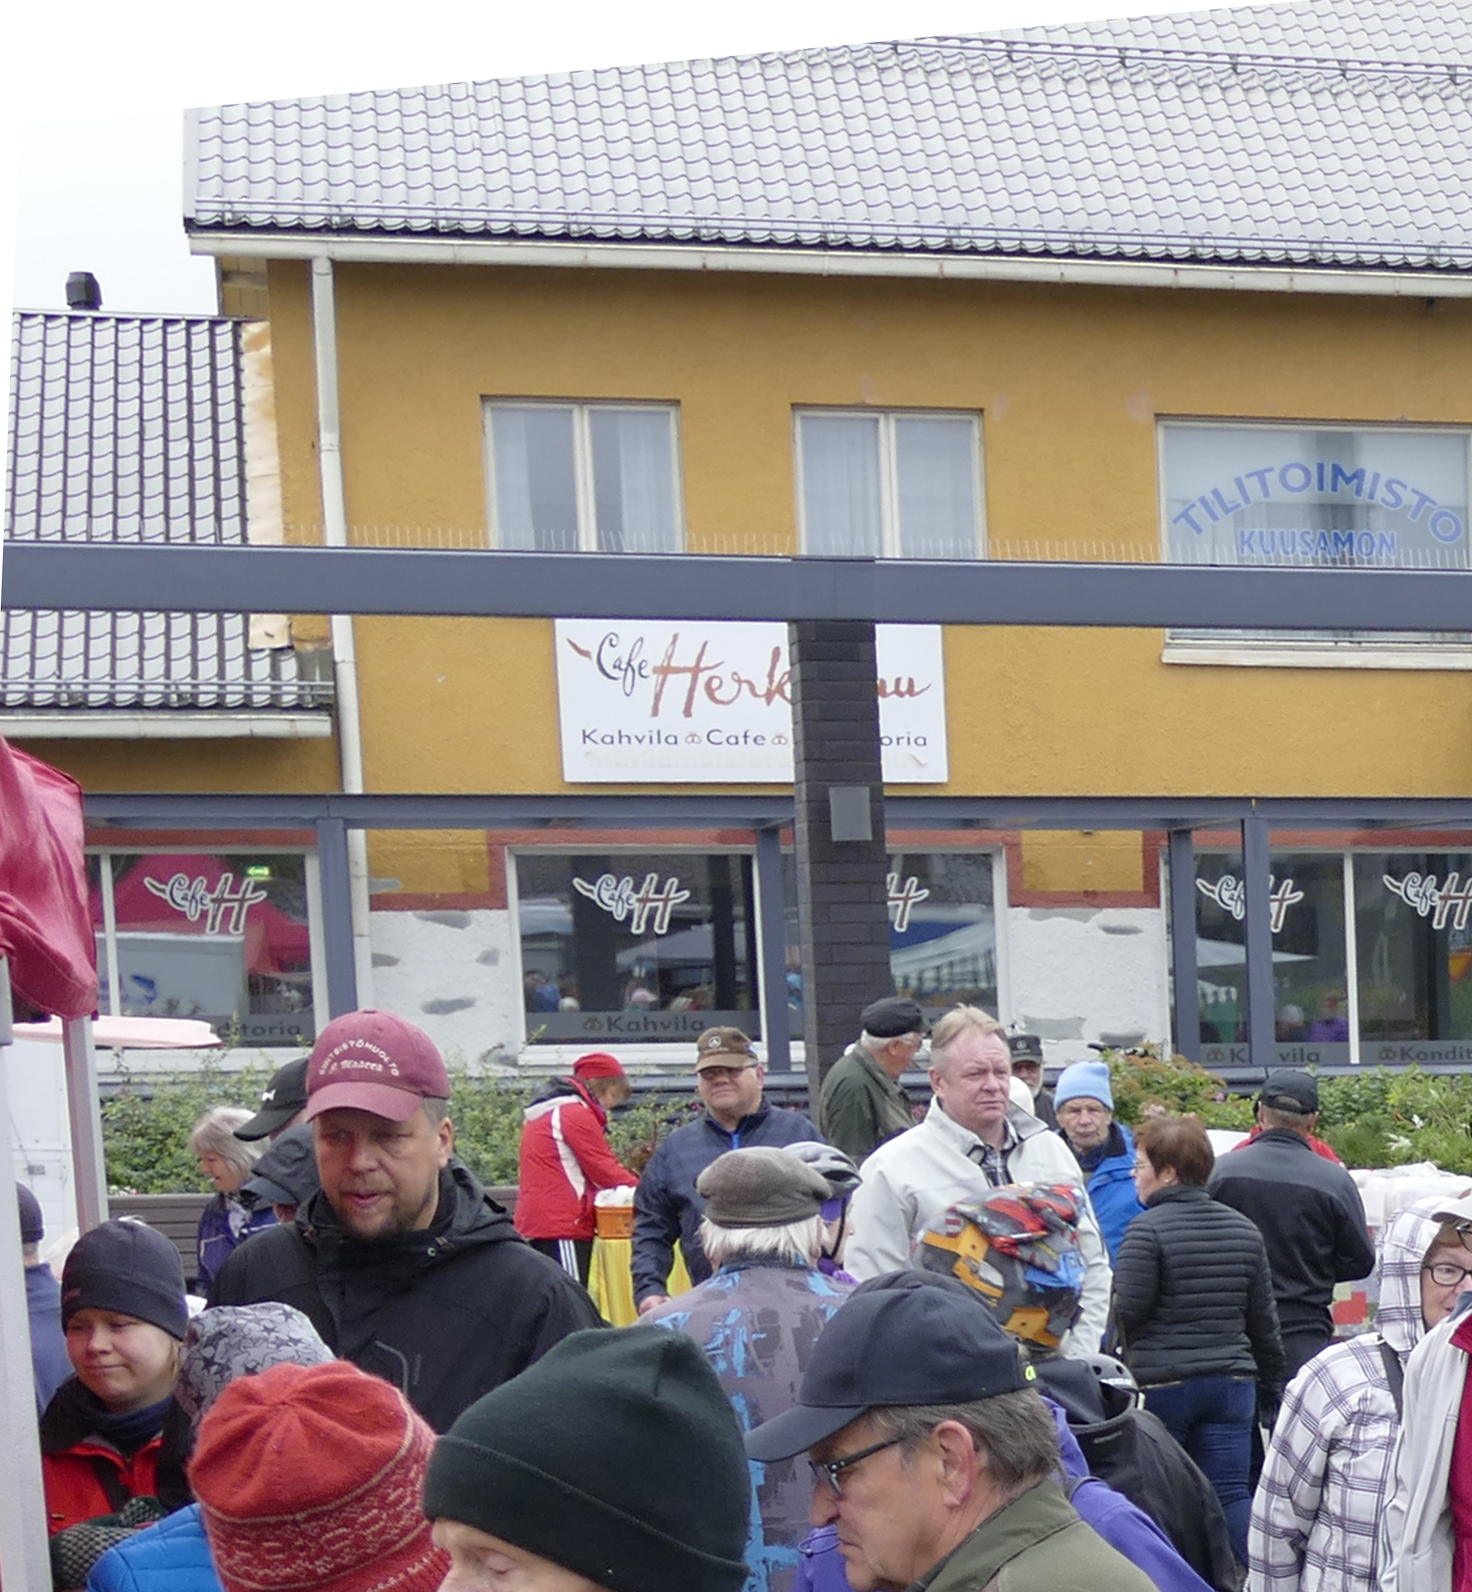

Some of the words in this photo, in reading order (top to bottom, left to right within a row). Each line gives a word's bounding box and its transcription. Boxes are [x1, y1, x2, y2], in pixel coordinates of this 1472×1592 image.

[1172, 461, 1463, 543] TILITOIMISTO
[1237, 529, 1398, 557] KUUSAMON
[596, 632, 651, 697] Cafe
[581, 729, 679, 746] Kahvila
[706, 729, 767, 746] Cafe
[168, 874, 211, 920] Cafe
[205, 873, 267, 934] H
[596, 874, 634, 921] Cafe
[630, 873, 690, 934] H
[1216, 875, 1244, 920] Caf
[1400, 872, 1438, 917] Cafe
[607, 1015, 706, 1033] Kahvila
[1230, 1044, 1321, 1064] Kvila
